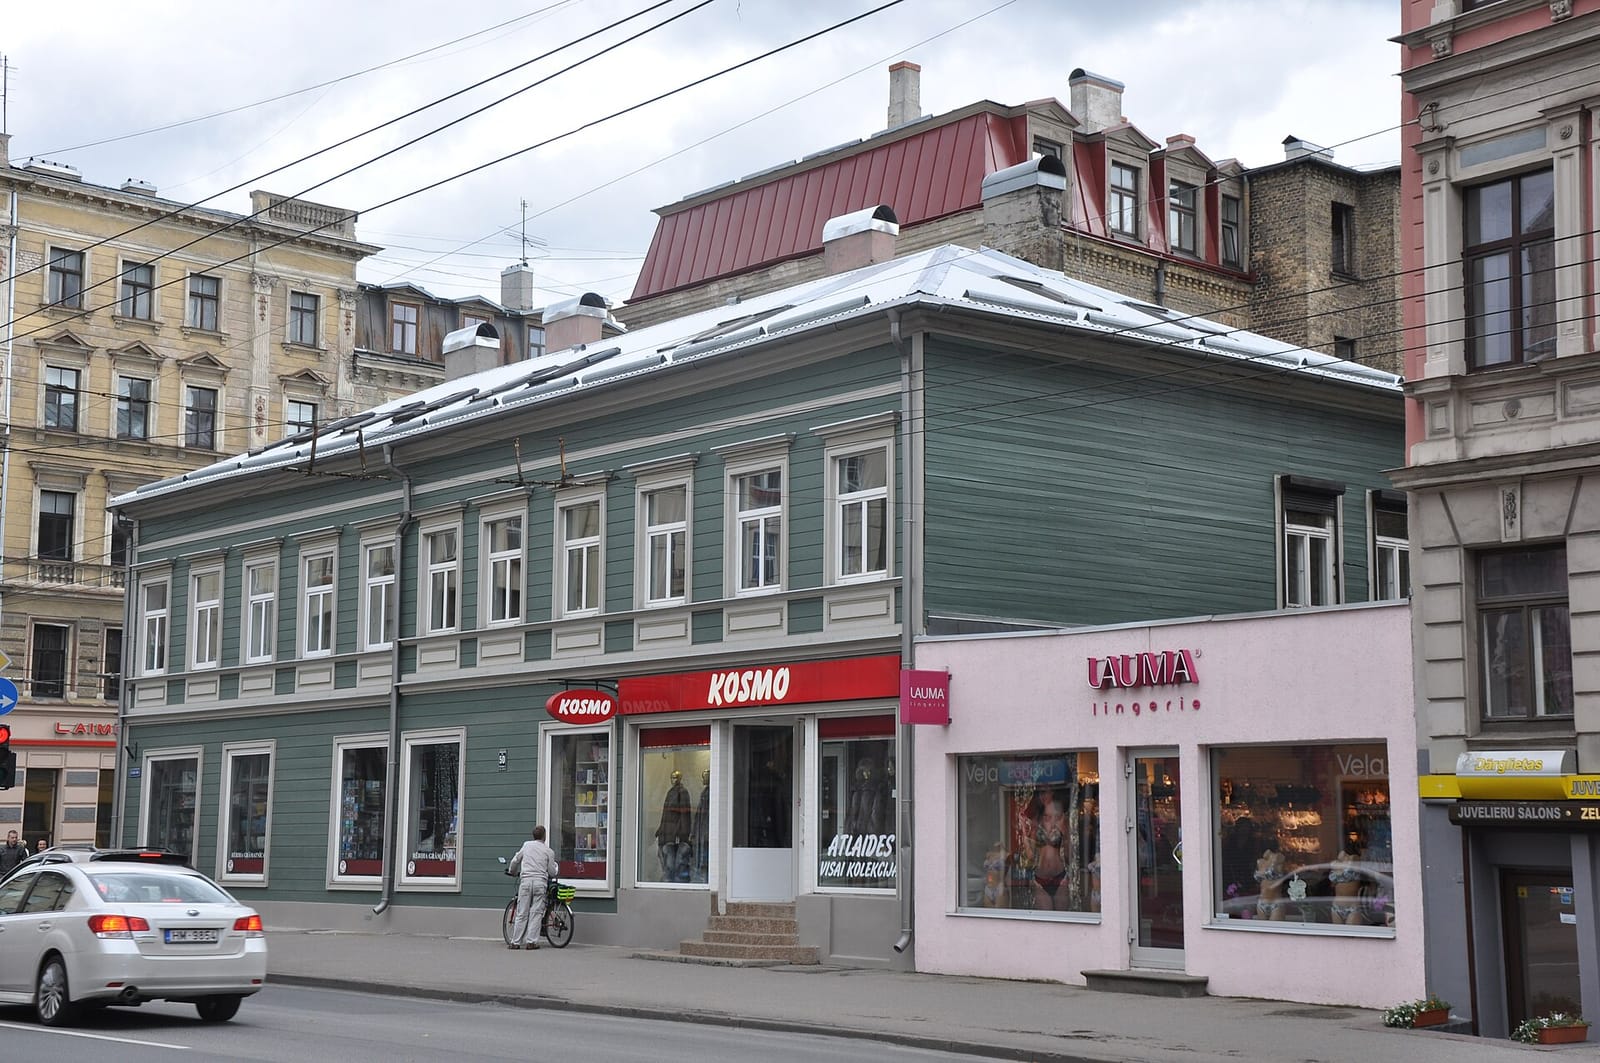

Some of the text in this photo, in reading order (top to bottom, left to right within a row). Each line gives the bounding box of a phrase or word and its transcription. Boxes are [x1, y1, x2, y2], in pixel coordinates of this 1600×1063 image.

[1087, 649, 1199, 689] LAUMA
[707, 667, 790, 706] KOSMO
[910, 686, 945, 700] LAUMA
[558, 698, 611, 715] KOSMO
[1092, 696, 1201, 716] lingerie
[1457, 806, 1515, 819] JUVELIERU
[1517, 807, 1561, 819] SALONS
[827, 833, 896, 858] ATLAIDES
[820, 860, 845, 878] VISAI
